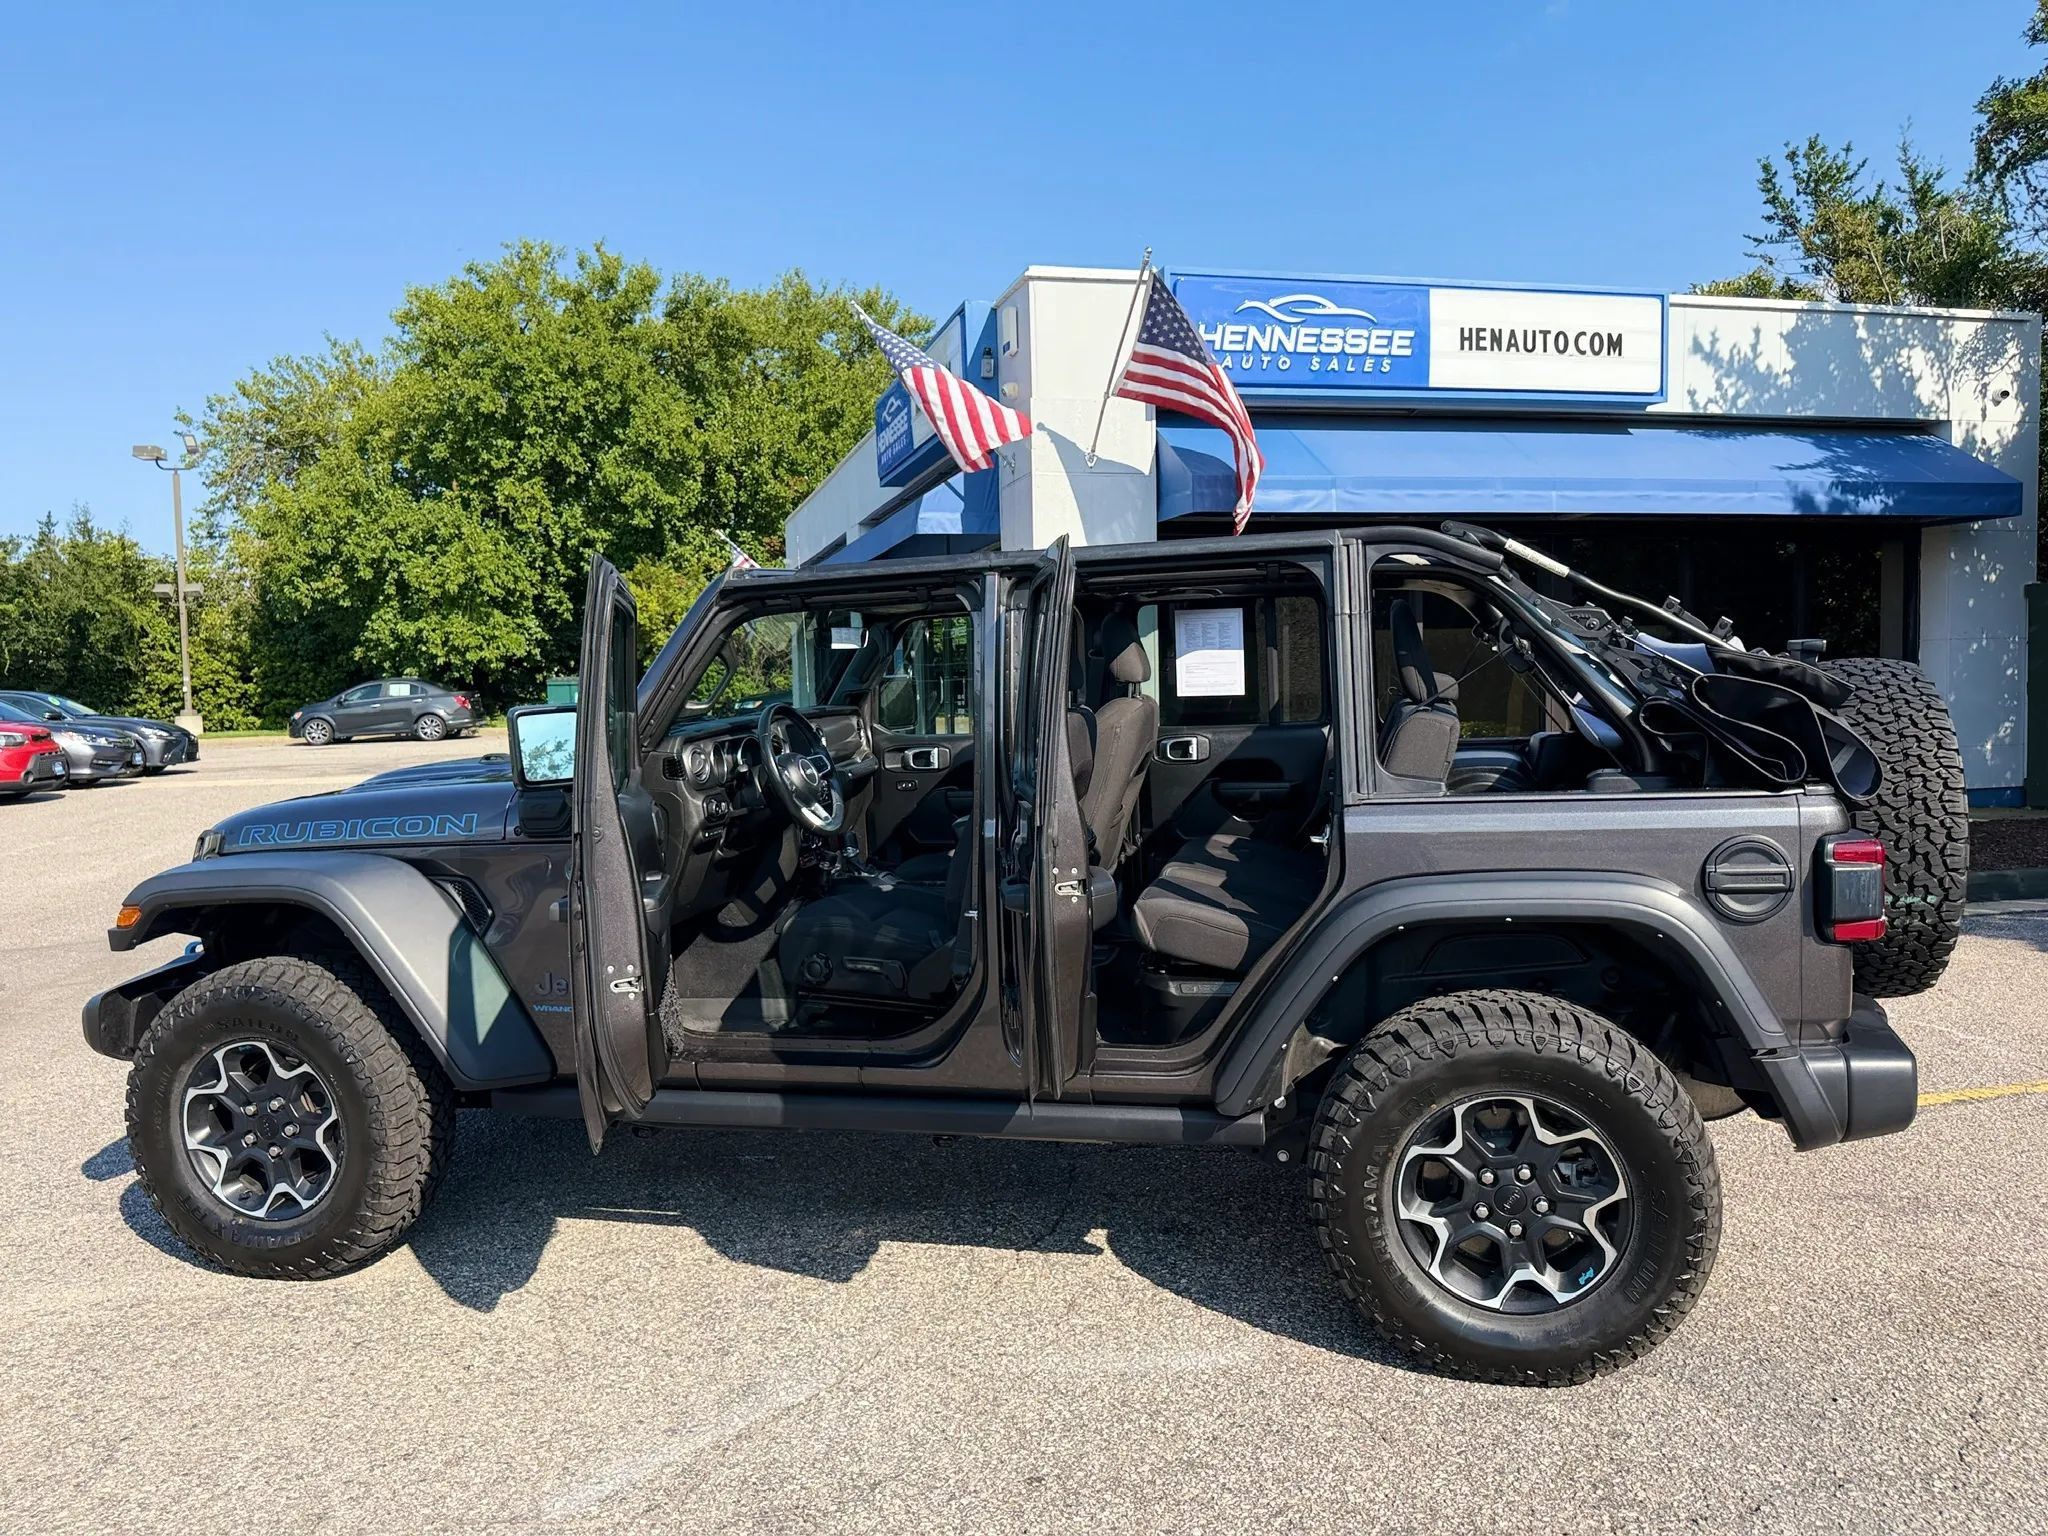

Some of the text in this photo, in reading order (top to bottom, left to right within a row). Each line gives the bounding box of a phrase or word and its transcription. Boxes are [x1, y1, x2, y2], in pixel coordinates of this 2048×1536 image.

[1198, 322, 1416, 356] HENNESSEE
[1221, 354, 1392, 373] AUTO SALES
[239, 813, 479, 846] RUBICON
